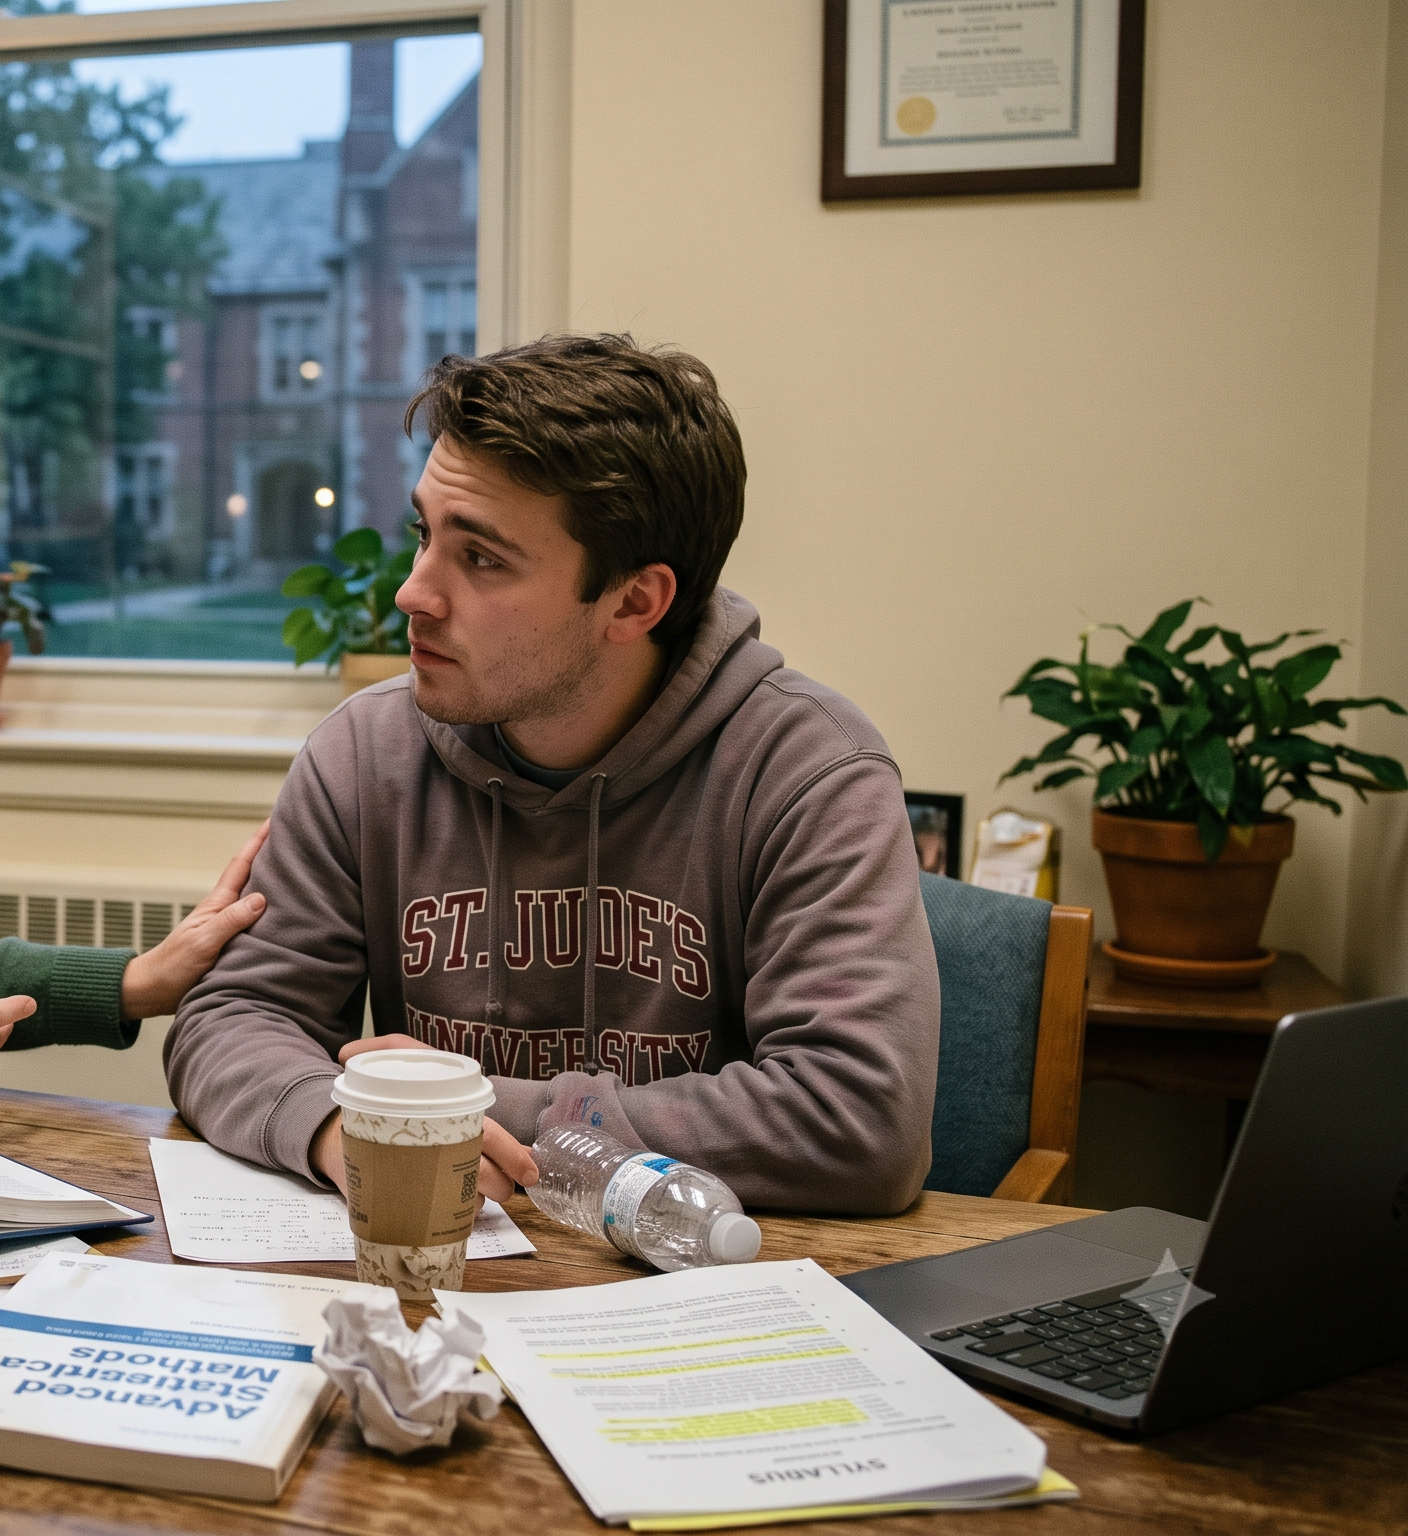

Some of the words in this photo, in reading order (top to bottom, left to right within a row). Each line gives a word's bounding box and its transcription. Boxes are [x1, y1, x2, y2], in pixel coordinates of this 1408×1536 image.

[402, 887, 489, 978] ST.
[504, 885, 711, 1000] JUDE'S
[69, 1346, 281, 1384] Mathods
[14, 1378, 259, 1422] Advanced
